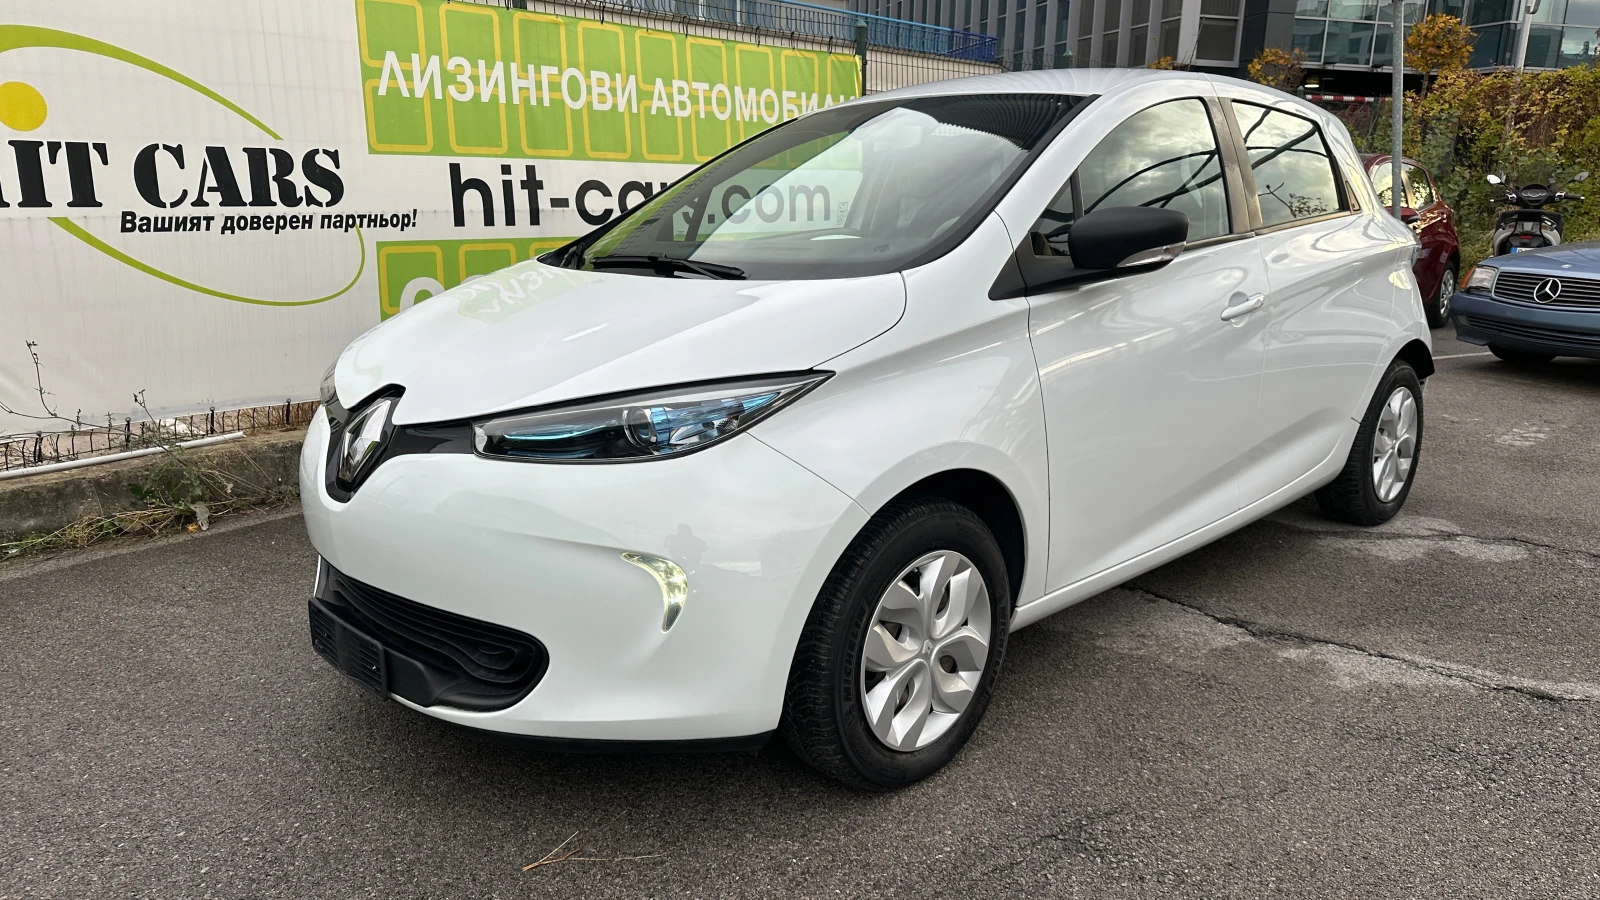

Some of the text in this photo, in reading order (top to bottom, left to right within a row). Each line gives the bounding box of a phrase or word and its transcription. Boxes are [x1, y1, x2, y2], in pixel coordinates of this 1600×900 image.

[377, 50, 638, 114] ЛИЗИНГОВИ
[0, 140, 345, 209] IT CARS
[120, 209, 417, 235] Вашият доверен партньор!
[843, 605, 866, 702] MICHELIN
[988, 606, 1008, 689] MICHELIN
